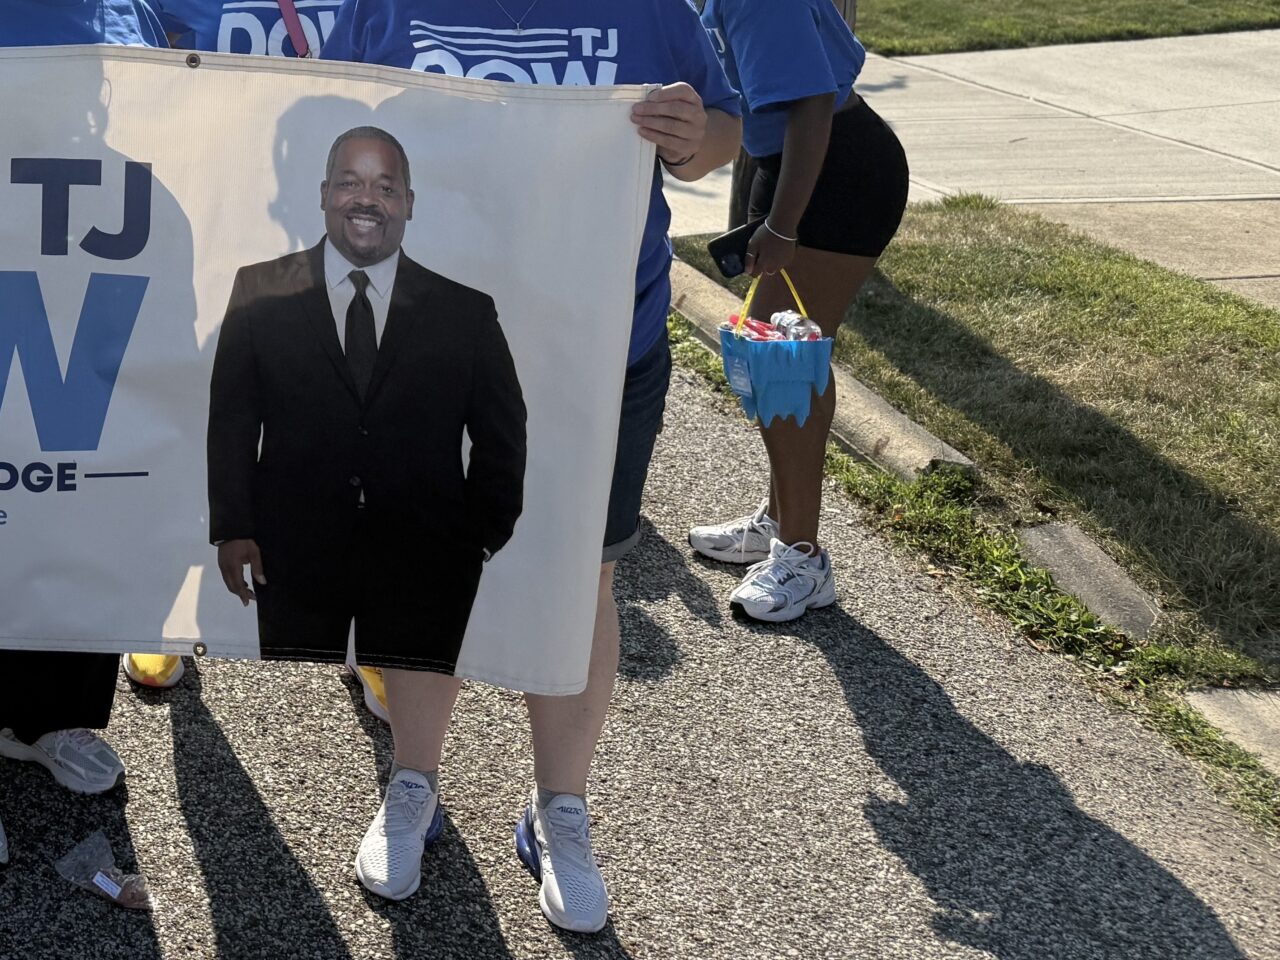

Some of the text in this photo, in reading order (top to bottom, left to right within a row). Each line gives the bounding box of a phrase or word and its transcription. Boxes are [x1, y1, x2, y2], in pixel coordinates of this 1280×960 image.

[216, 10, 336, 59] DO
[571, 27, 619, 58] TJ
[10, 157, 152, 260] TJ
